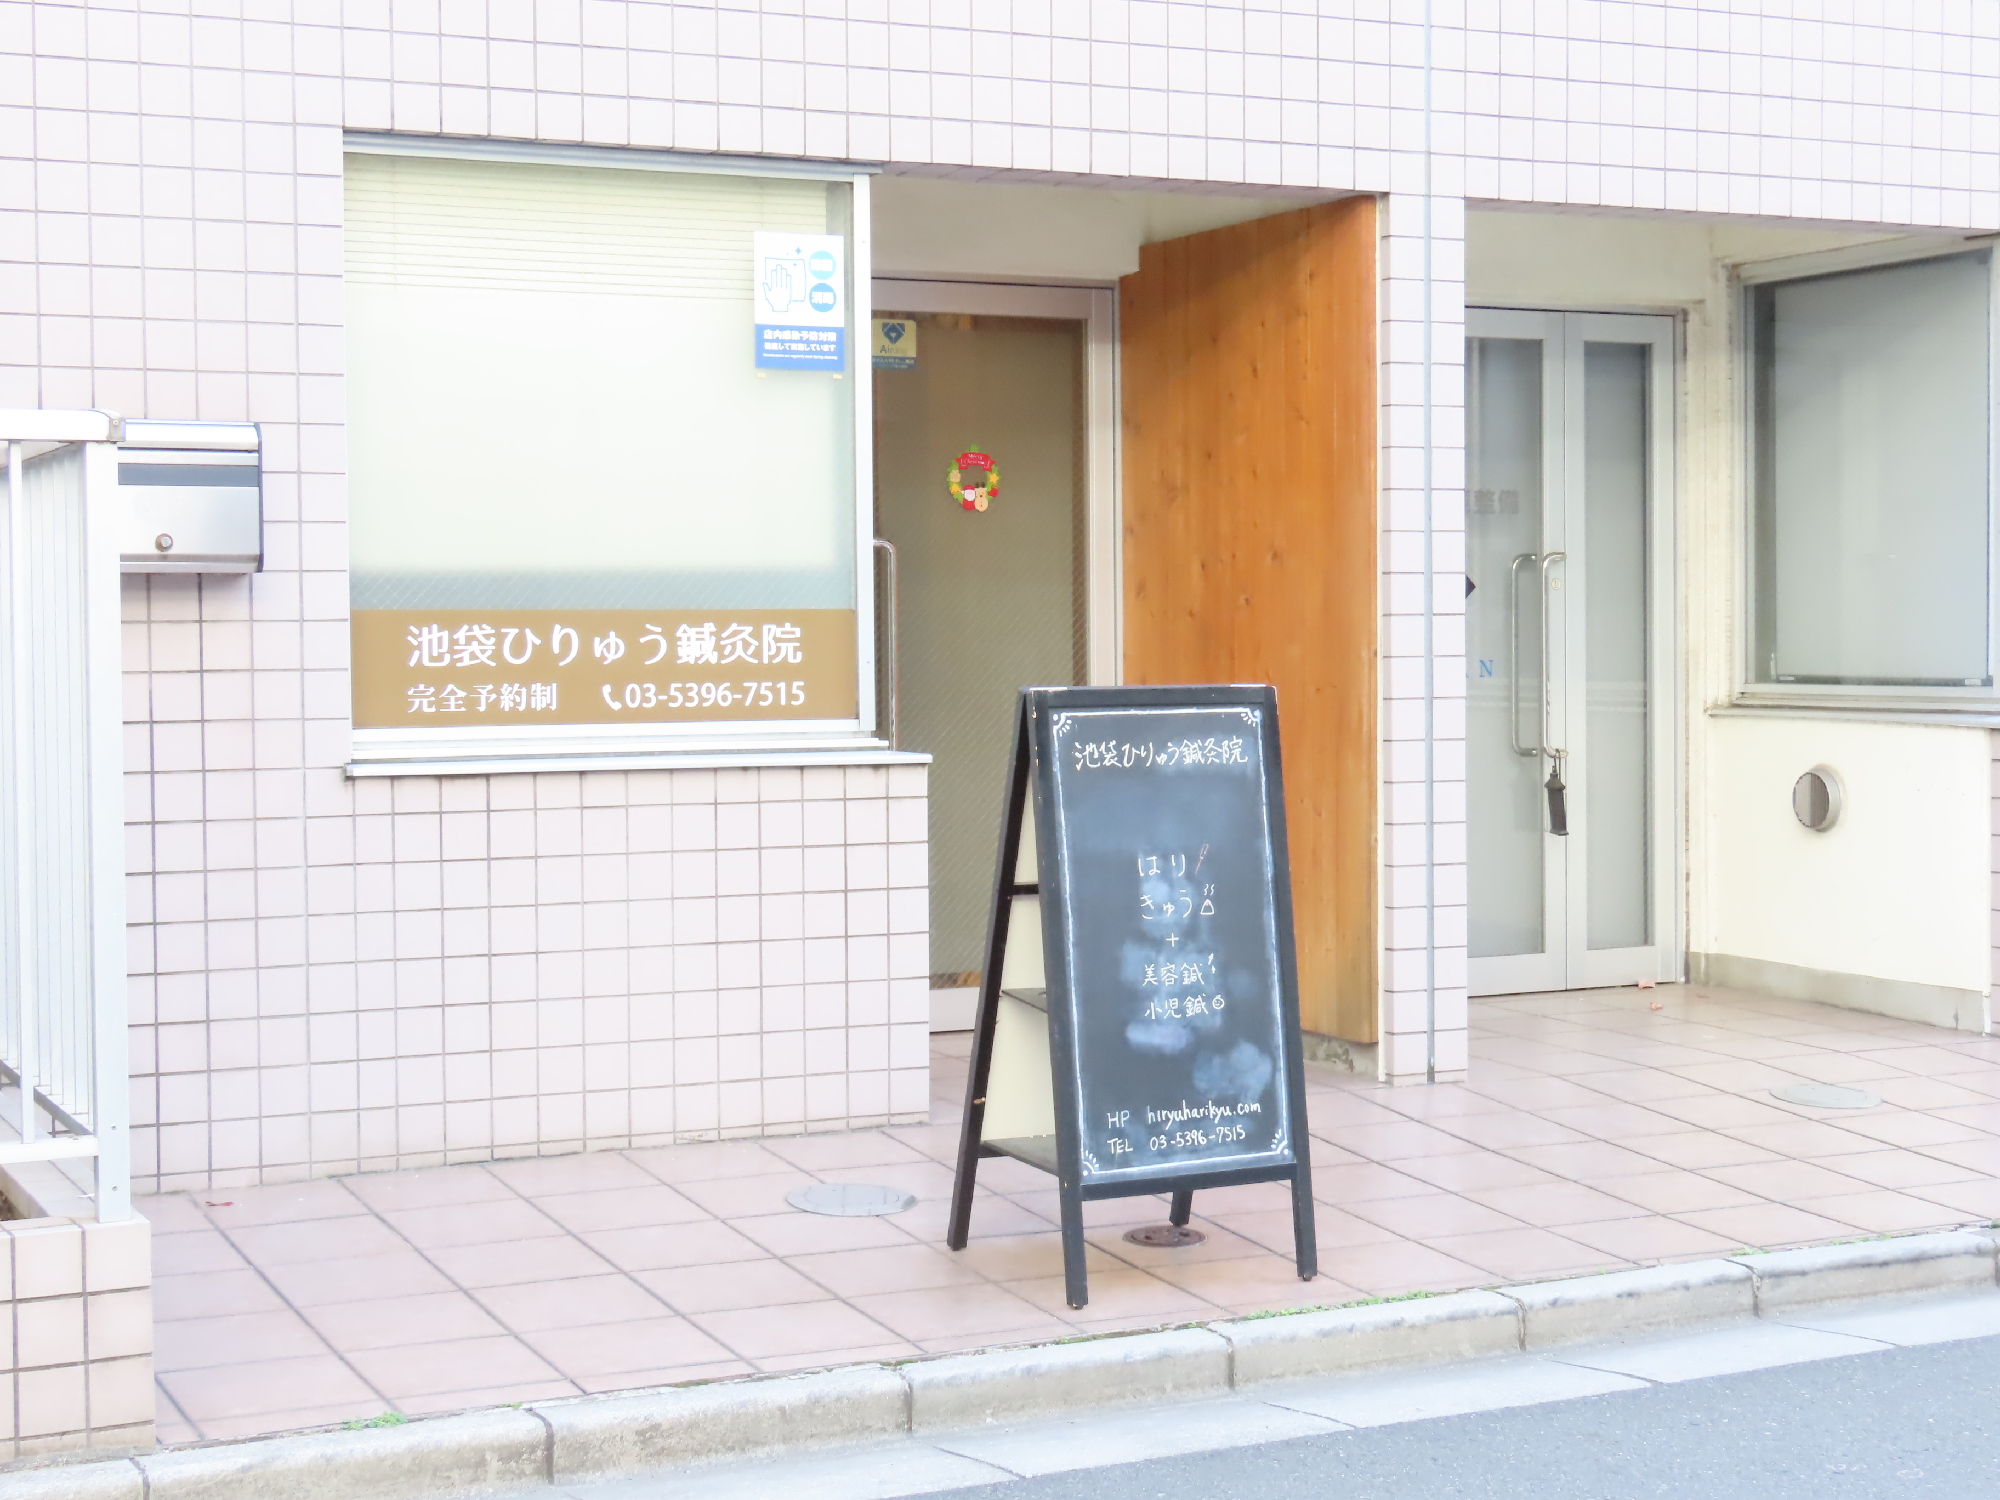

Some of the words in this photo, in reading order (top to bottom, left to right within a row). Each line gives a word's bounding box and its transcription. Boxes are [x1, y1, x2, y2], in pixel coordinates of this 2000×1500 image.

[1465, 489, 1520, 515] 整備
[407, 622, 804, 668] 池袋ひりゅう鍼灸院
[407, 682, 558, 714] 完全予約制
[625, 680, 806, 709] 03-5396-7515
[1073, 735, 1248, 771] 池袋ひりゅう鍼灸院
[1138, 854, 1187, 877] はり
[1140, 889, 1193, 919] きゅう
[1142, 962, 1205, 987] 美容鍼
[1144, 992, 1209, 1020] 小児鍼
[1107, 1109, 1131, 1129] HP
[1147, 1099, 1262, 1130] hiryuharikyu.com
[1106, 1137, 1134, 1155] TEL
[1150, 1124, 1246, 1151] 03-5396-7515
